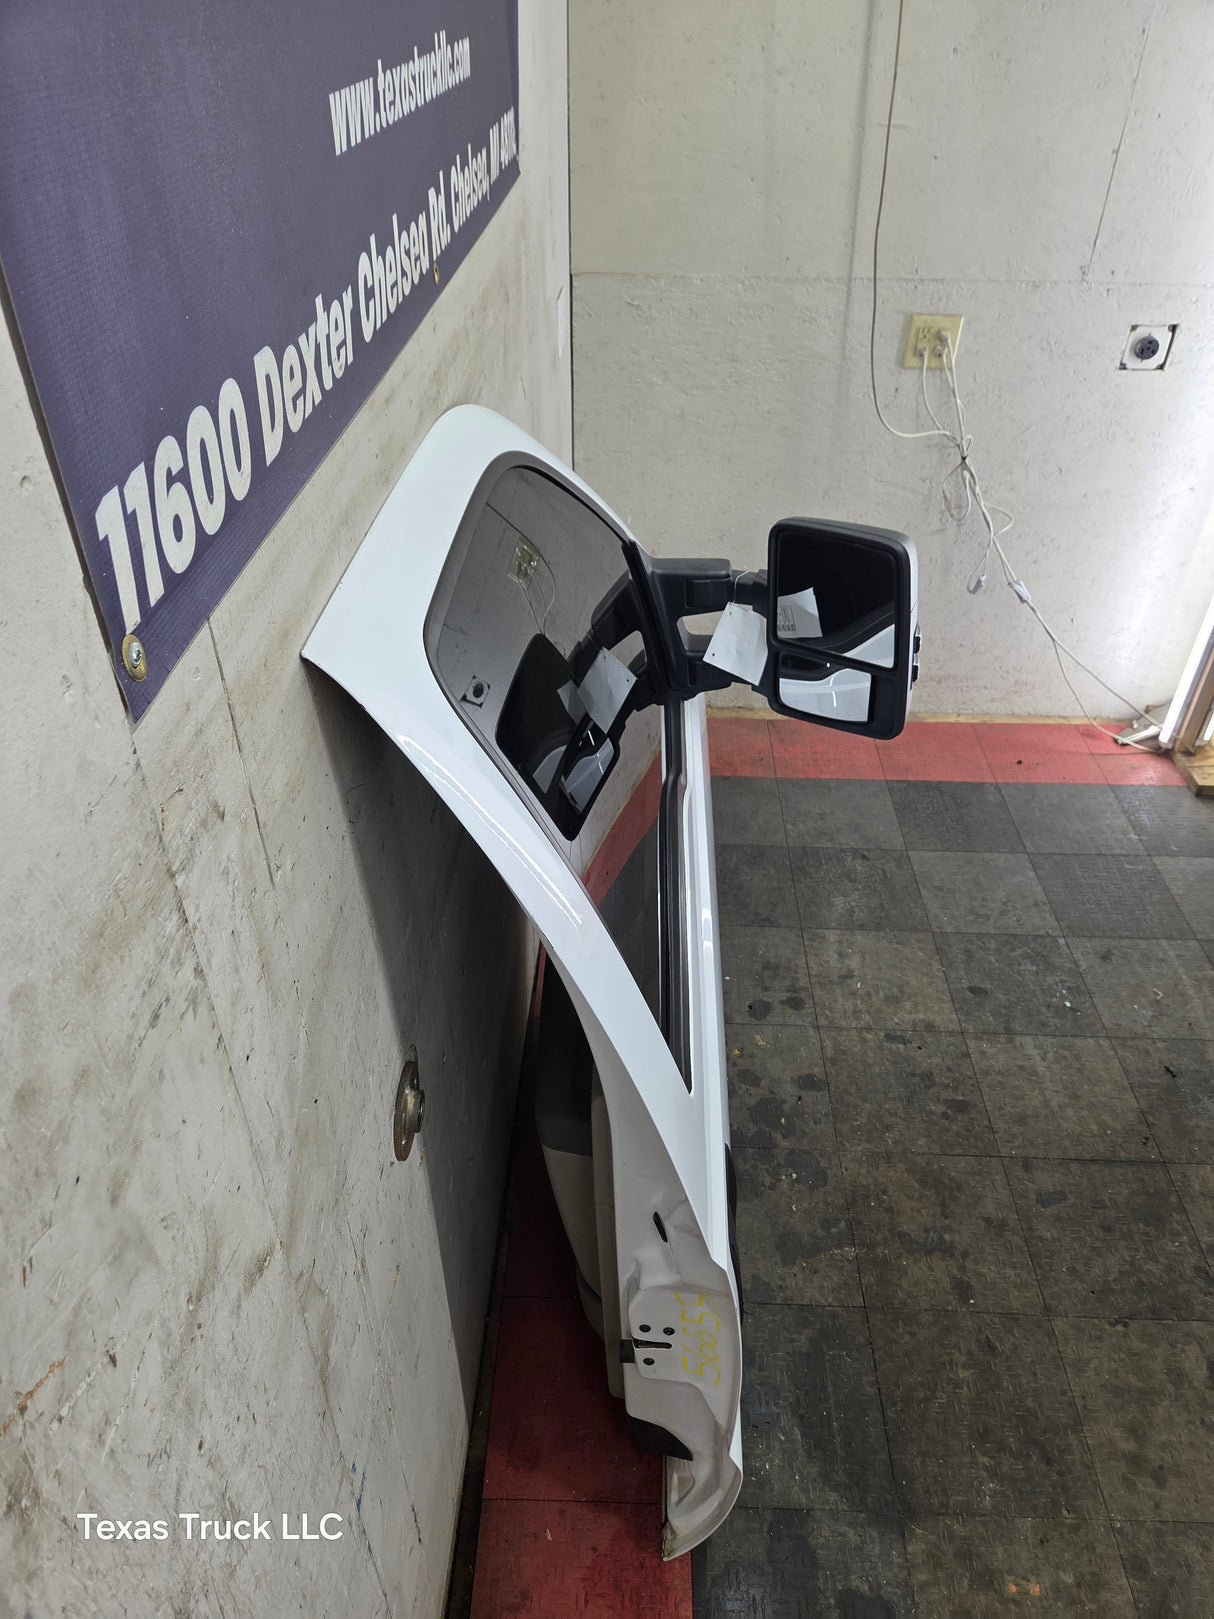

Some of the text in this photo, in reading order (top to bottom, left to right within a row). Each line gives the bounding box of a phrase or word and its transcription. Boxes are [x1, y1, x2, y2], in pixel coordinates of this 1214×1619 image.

[328, 30, 471, 156] www.texastruckllc.com
[95, 377, 252, 635] 11600
[253, 284, 354, 467] Dexter
[357, 212, 430, 342] Chelsea
[427, 169, 451, 262] Rd.
[450, 143, 490, 233] Chelsea,
[489, 121, 501, 184] MI
